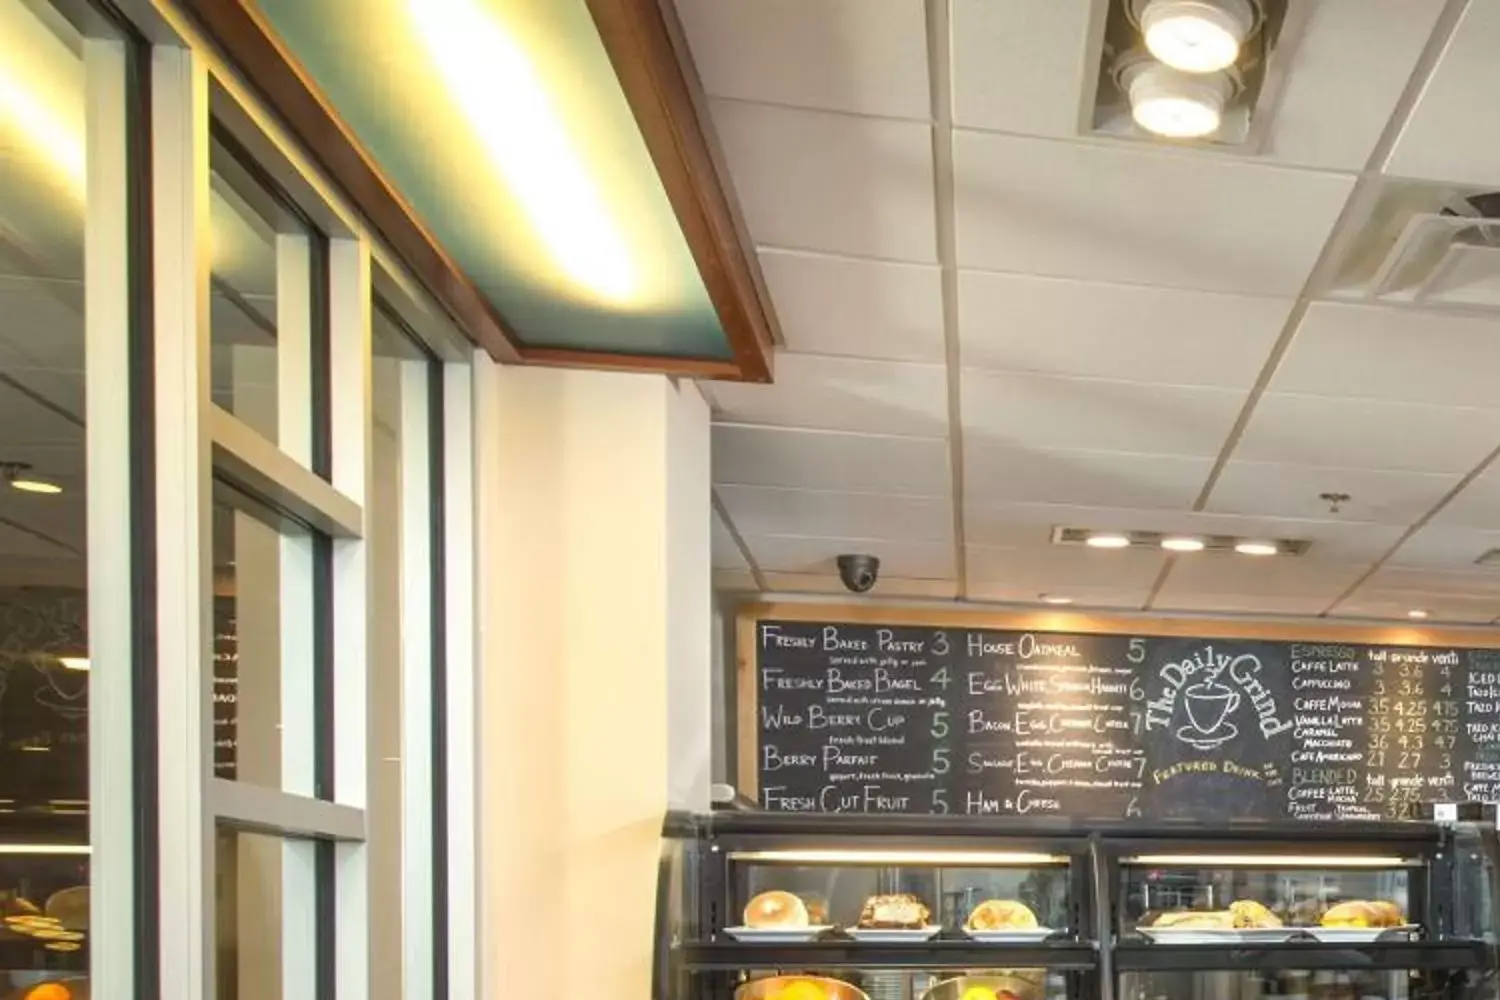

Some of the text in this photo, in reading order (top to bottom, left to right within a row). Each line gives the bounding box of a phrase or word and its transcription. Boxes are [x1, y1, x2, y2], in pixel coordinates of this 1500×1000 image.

[876, 629, 924, 651] PASTRY
[931, 631, 949, 655] 3
[967, 632, 1146, 663] HOUSE OATMEAL 5
[1329, 660, 1359, 673] LATTE
[1440, 667, 1450, 678] 4
[1367, 650, 1387, 662] tall
[1431, 651, 1458, 664] venti
[762, 667, 951, 693] FRESHLY BAKED BAGEL 4
[968, 672, 1003, 695] EGG
[1004, 672, 1047, 697] WHITE
[1129, 677, 1145, 701] 6
[1145, 645, 1293, 740] The Daily Grind
[1291, 678, 1351, 690] CAPPUCCINO
[1373, 680, 1385, 695] 3
[1440, 682, 1452, 697] 4
[762, 704, 950, 738] WILD BERRY CUP 5
[1129, 712, 1142, 736] 7
[1333, 714, 1363, 728] LATTE
[763, 745, 950, 774] BERRY PARFAIT 5
[1132, 757, 1147, 779] 7
[1439, 754, 1451, 768] 3
[1292, 768, 1357, 785] BLENDED
[1366, 774, 1385, 786] tall
[1389, 775, 1424, 788] grande
[763, 785, 950, 815] FRESH CUT FRUIT 5
[966, 790, 1000, 815] HAM
